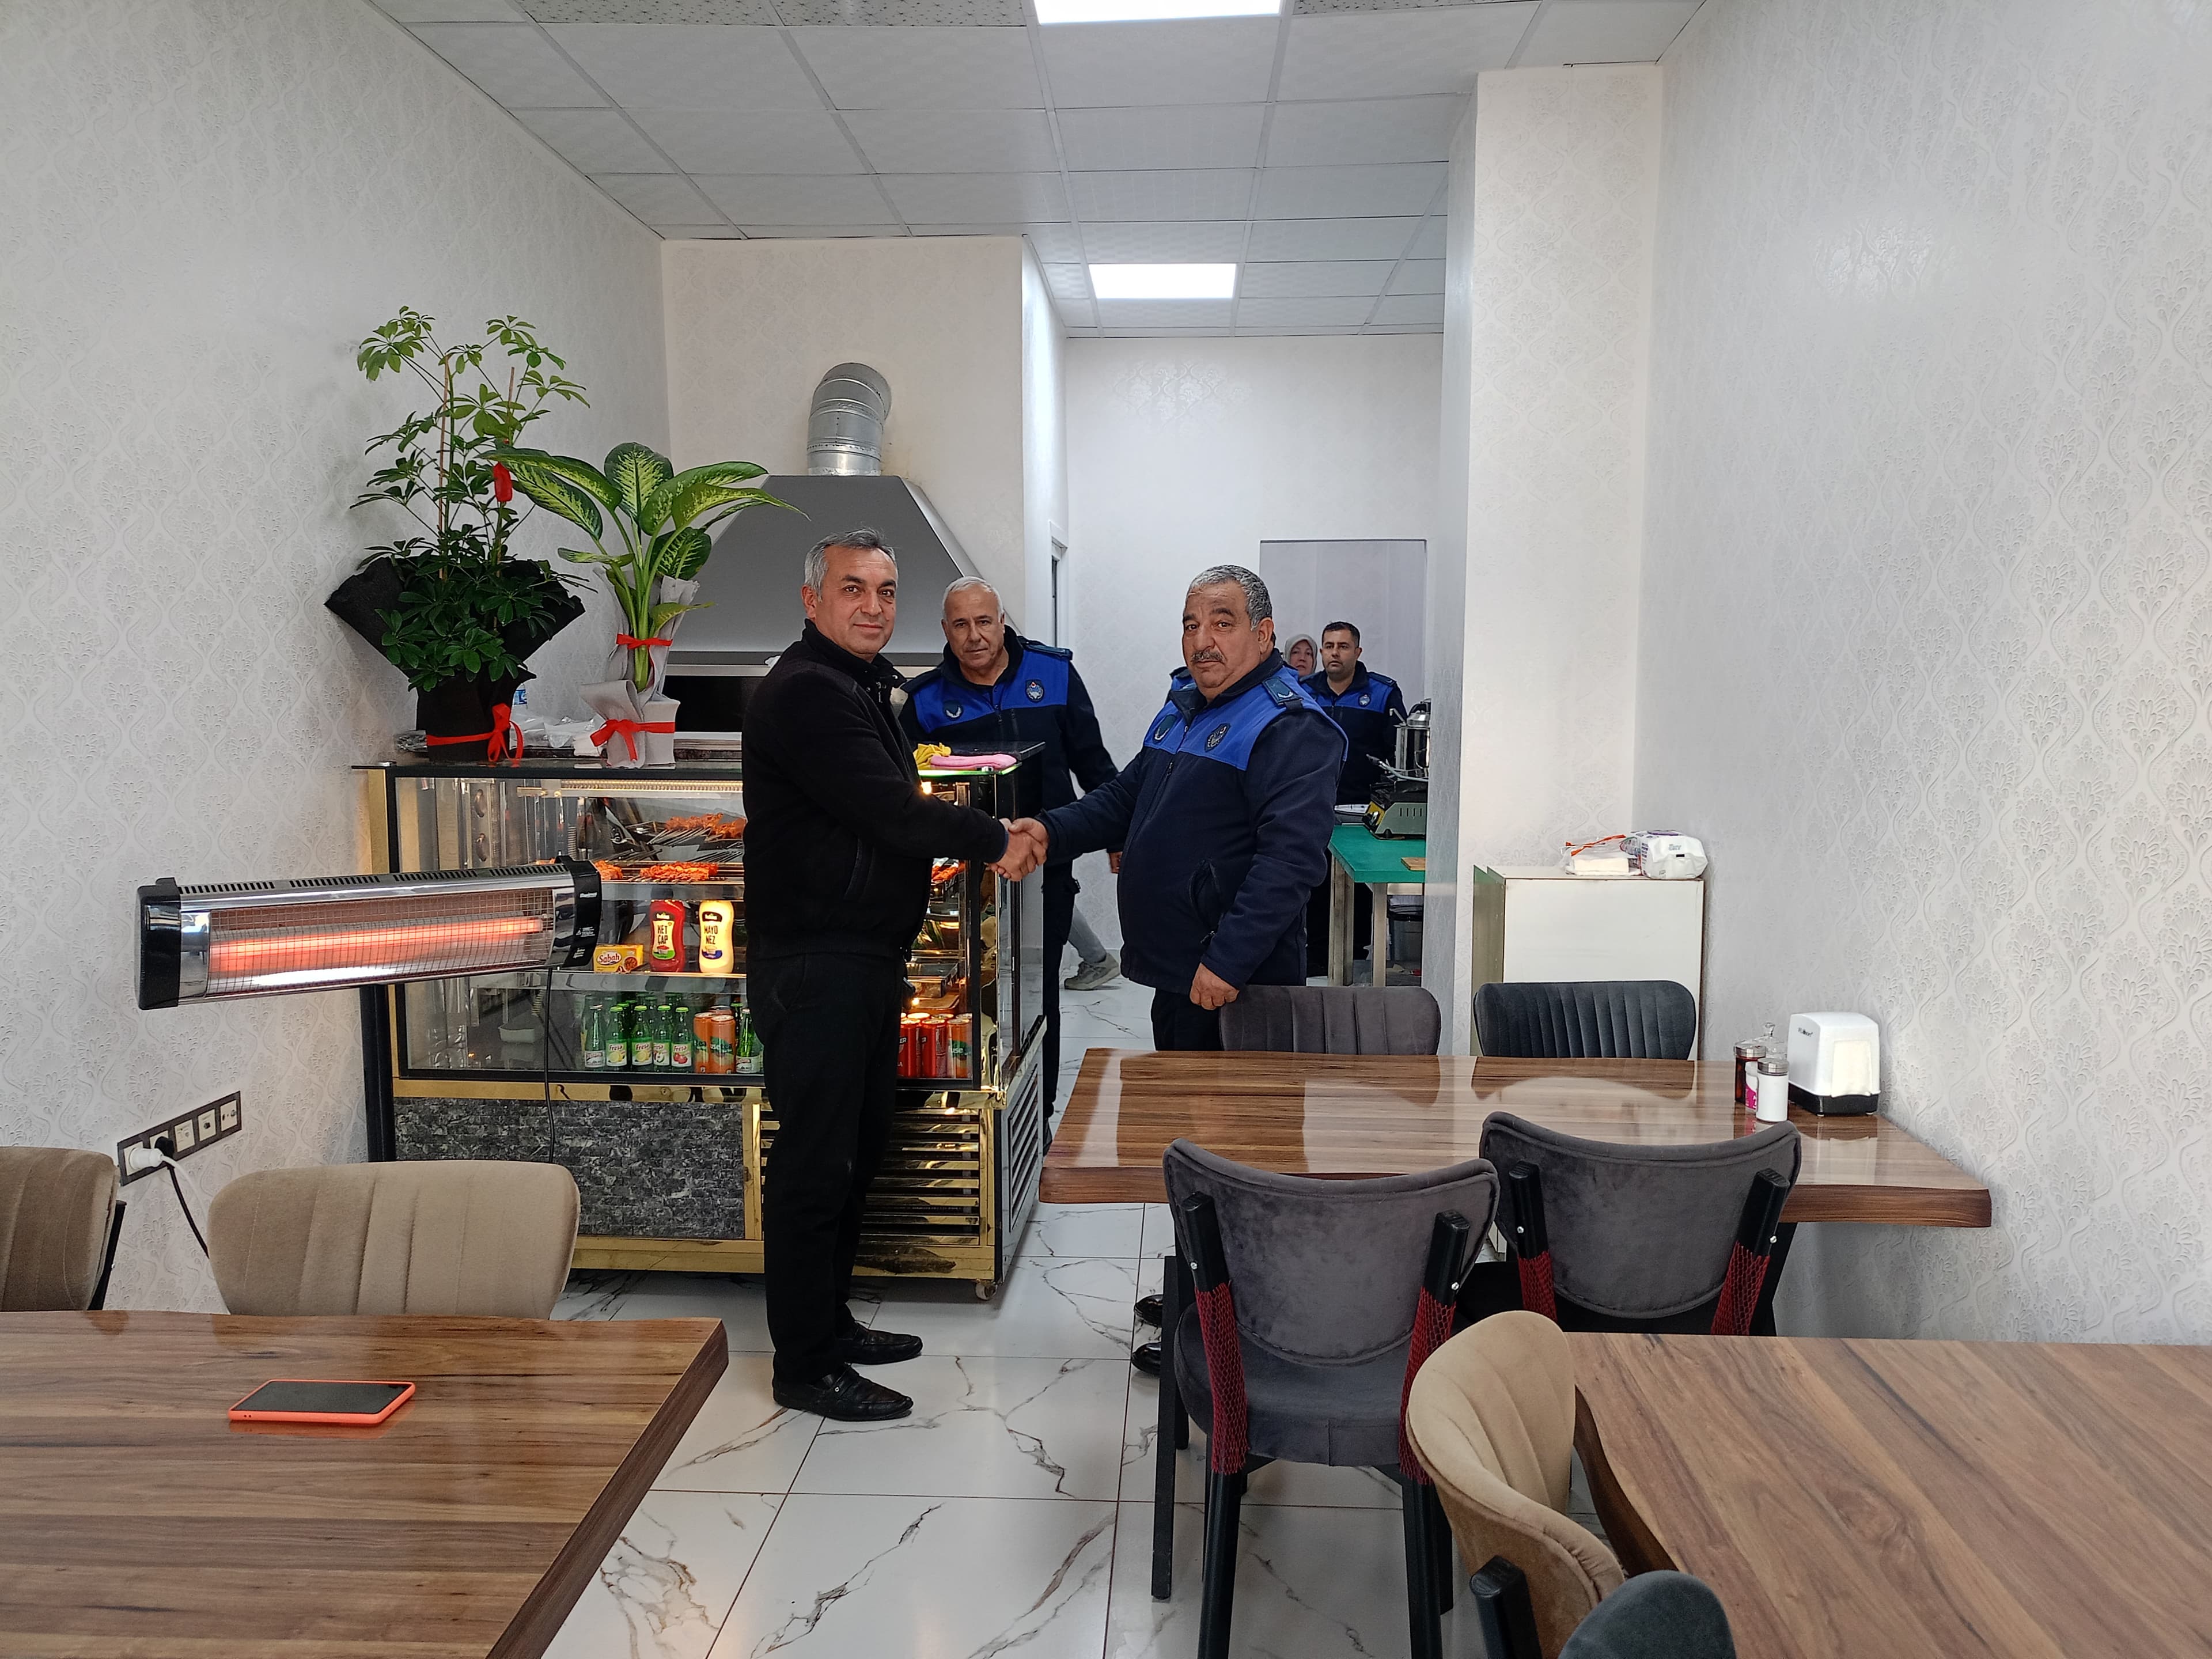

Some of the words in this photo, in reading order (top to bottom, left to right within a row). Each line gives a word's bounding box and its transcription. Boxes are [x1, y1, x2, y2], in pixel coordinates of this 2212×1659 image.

[657, 925, 668, 934] KET
[704, 925, 718, 934] MAYO
[657, 935, 668, 945] ÇAP
[706, 935, 715, 945] NEZ
[599, 953, 620, 963] Sabah
